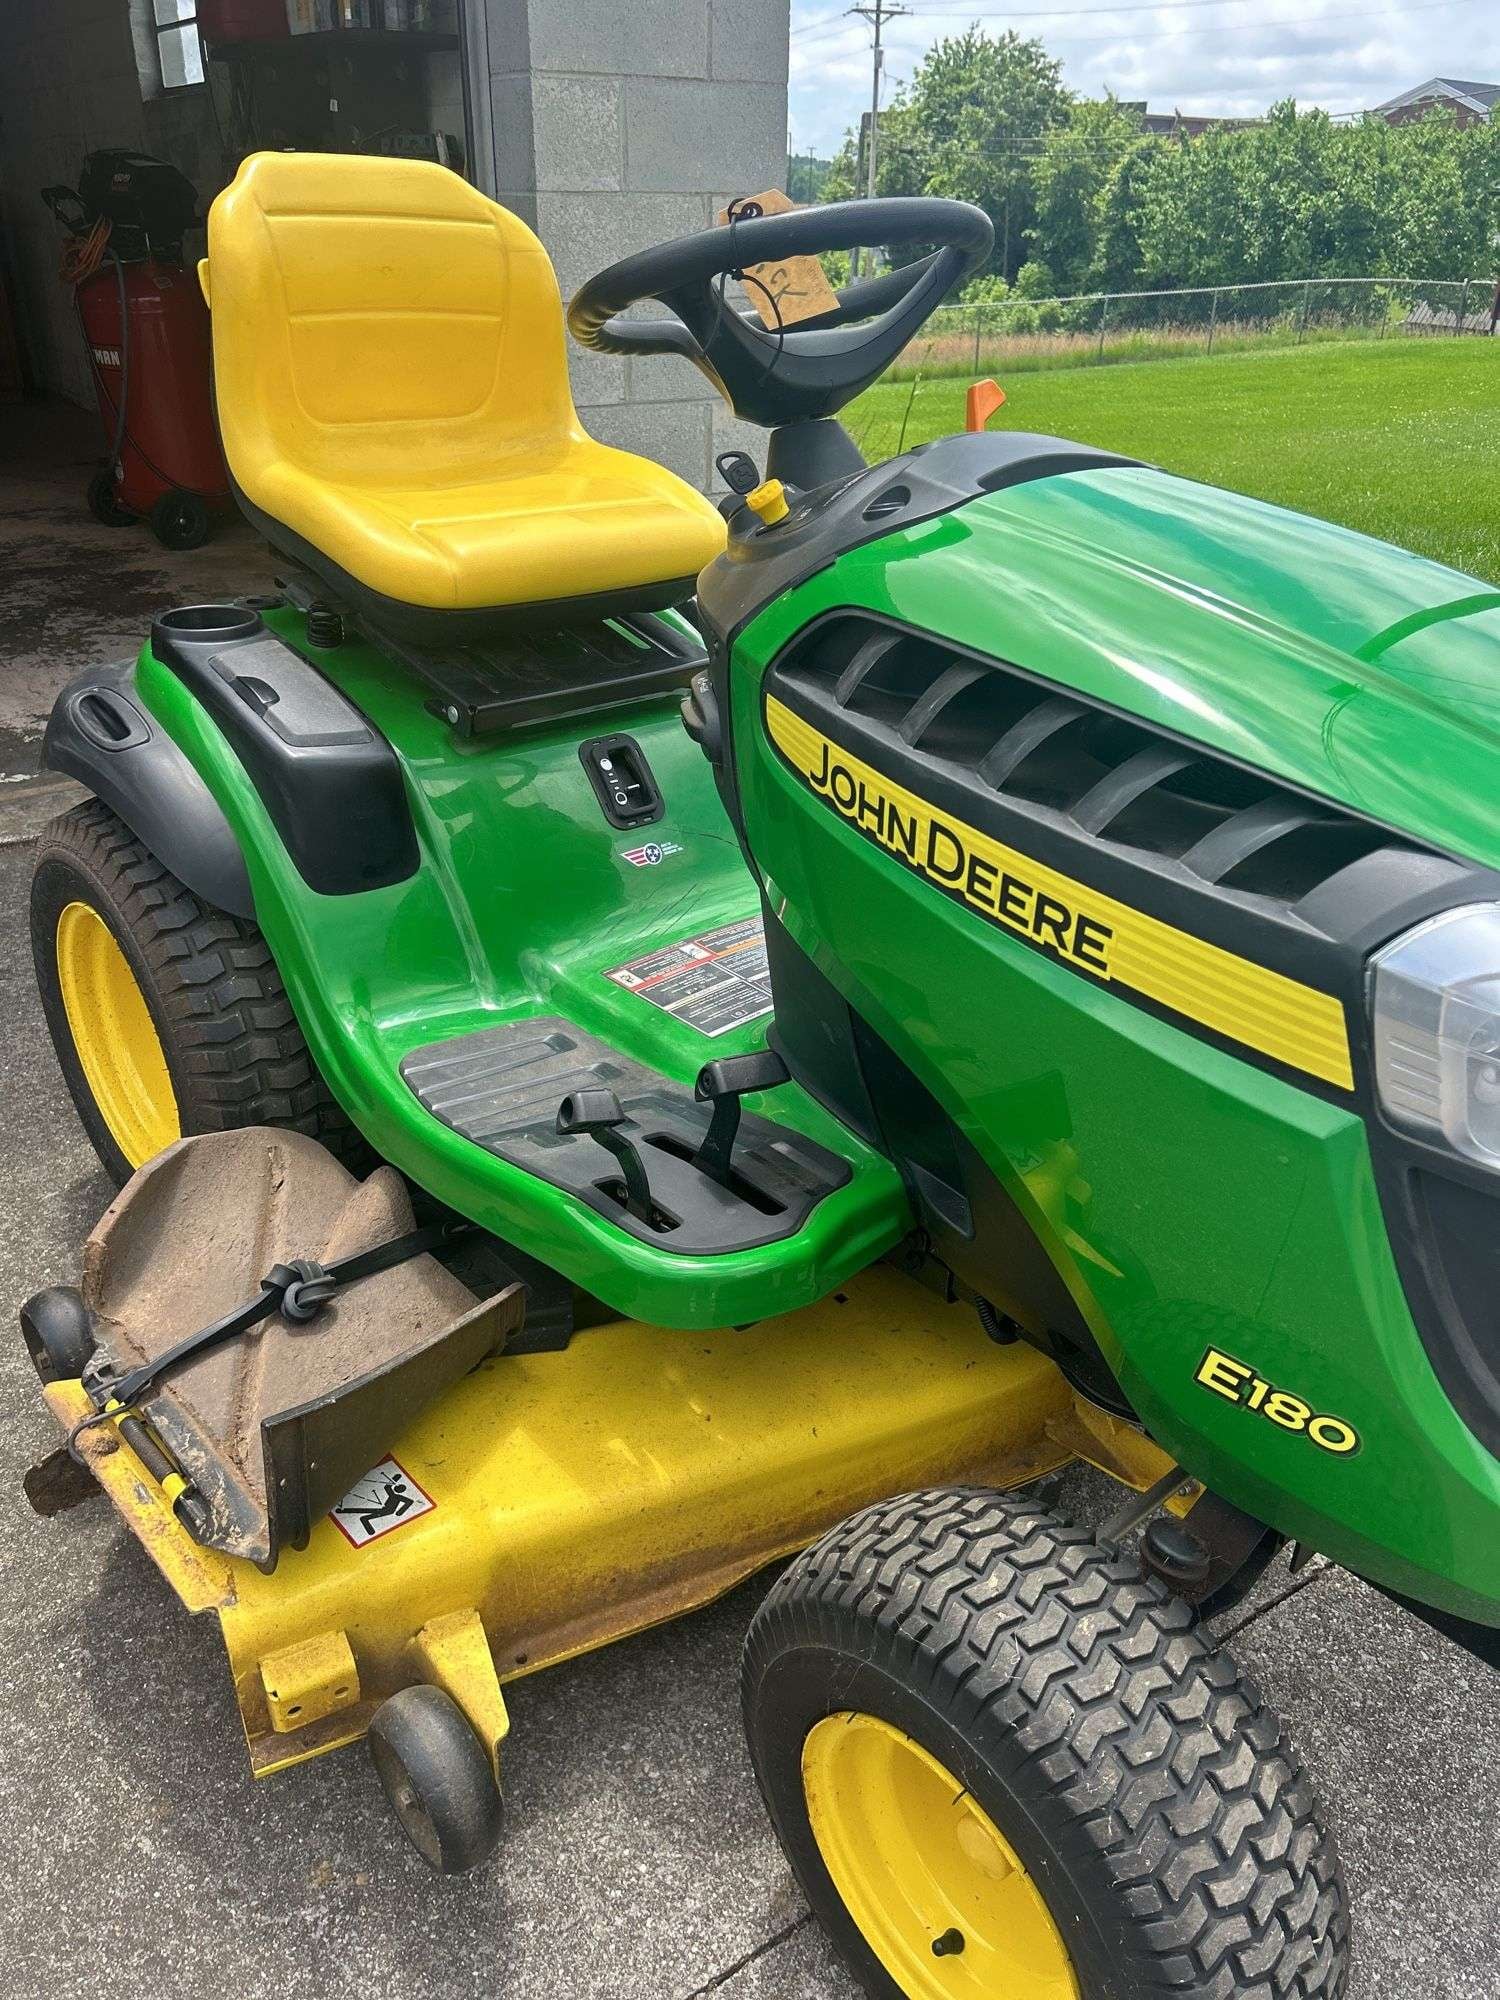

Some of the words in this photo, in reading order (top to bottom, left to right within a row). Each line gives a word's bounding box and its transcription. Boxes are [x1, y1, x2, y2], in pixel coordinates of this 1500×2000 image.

[809, 743, 918, 859] JOHN
[926, 818, 1114, 973] DEERE
[1197, 1350, 1356, 1453] E180
